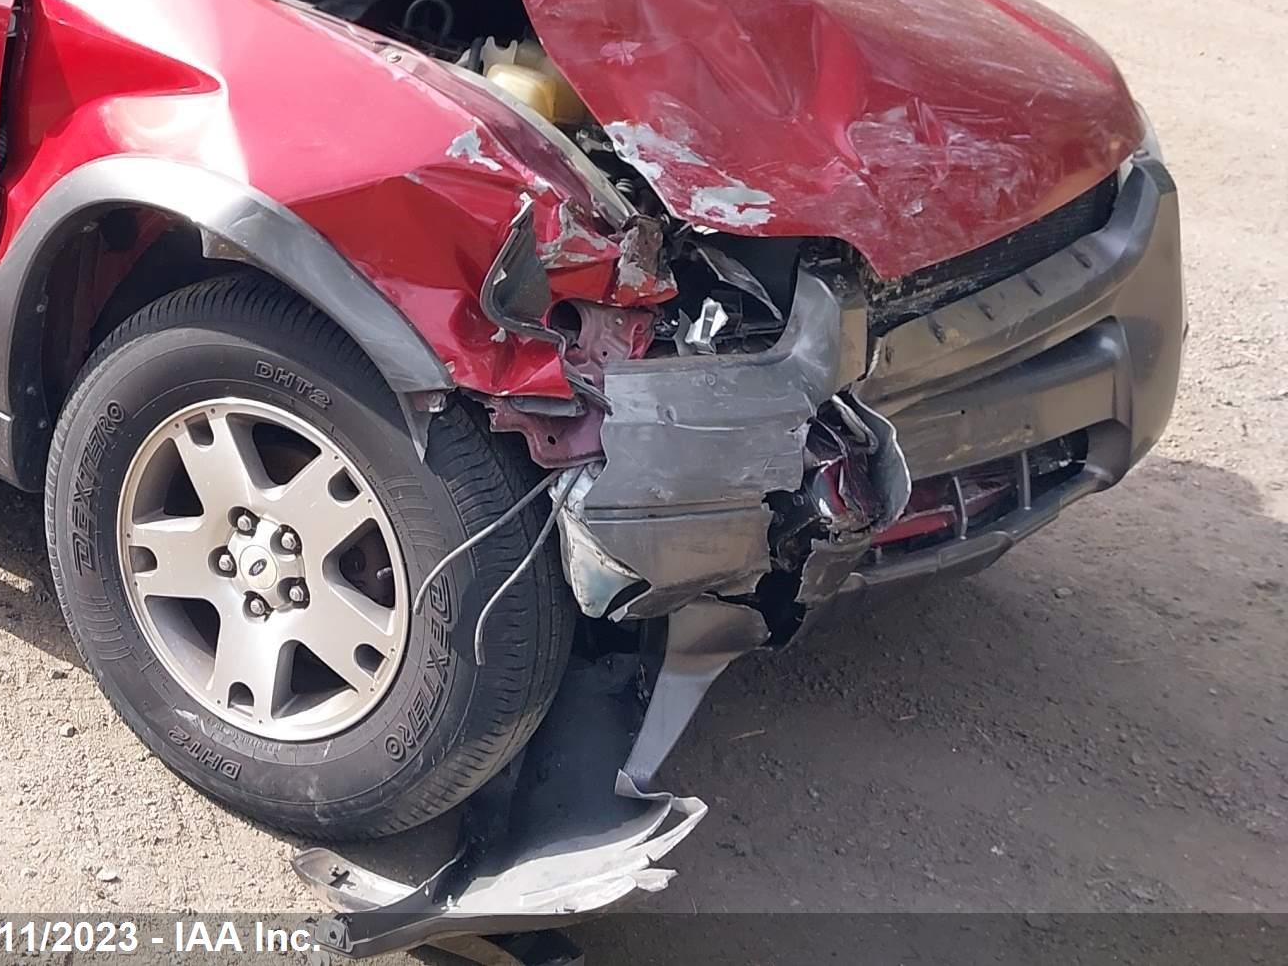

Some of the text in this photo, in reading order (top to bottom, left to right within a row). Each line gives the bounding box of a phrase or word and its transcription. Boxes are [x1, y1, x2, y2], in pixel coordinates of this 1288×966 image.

[254, 359, 333, 411] DHT2
[71, 399, 125, 577] DEXTERO
[384, 572, 453, 762] DEXTERO
[167, 724, 244, 781] DHT2
